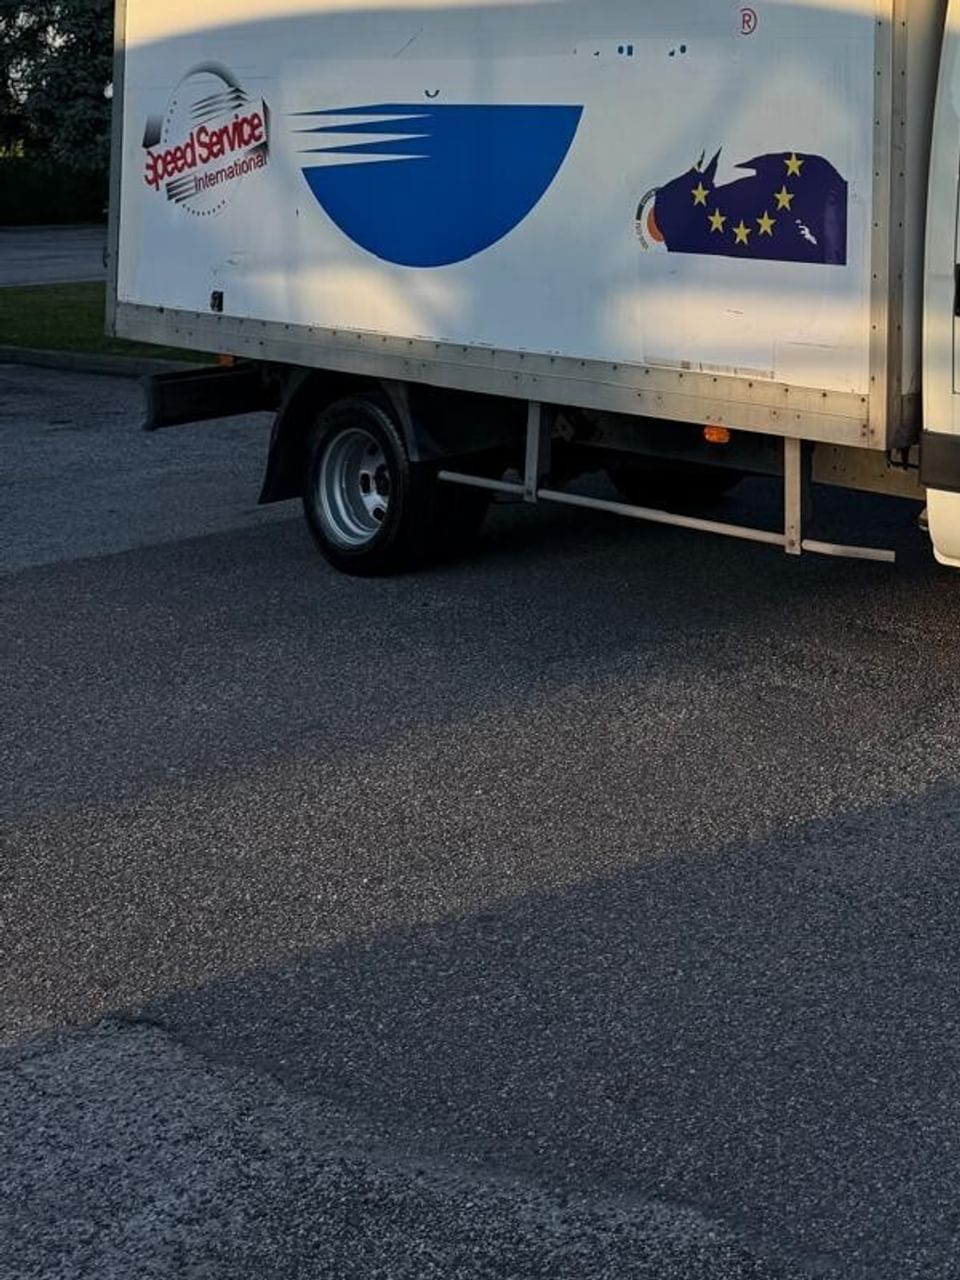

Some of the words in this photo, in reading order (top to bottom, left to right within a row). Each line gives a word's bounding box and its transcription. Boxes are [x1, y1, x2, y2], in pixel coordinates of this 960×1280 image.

[144, 132, 197, 191] Speed
[196, 113, 264, 163] Service
[194, 152, 268, 193] International
